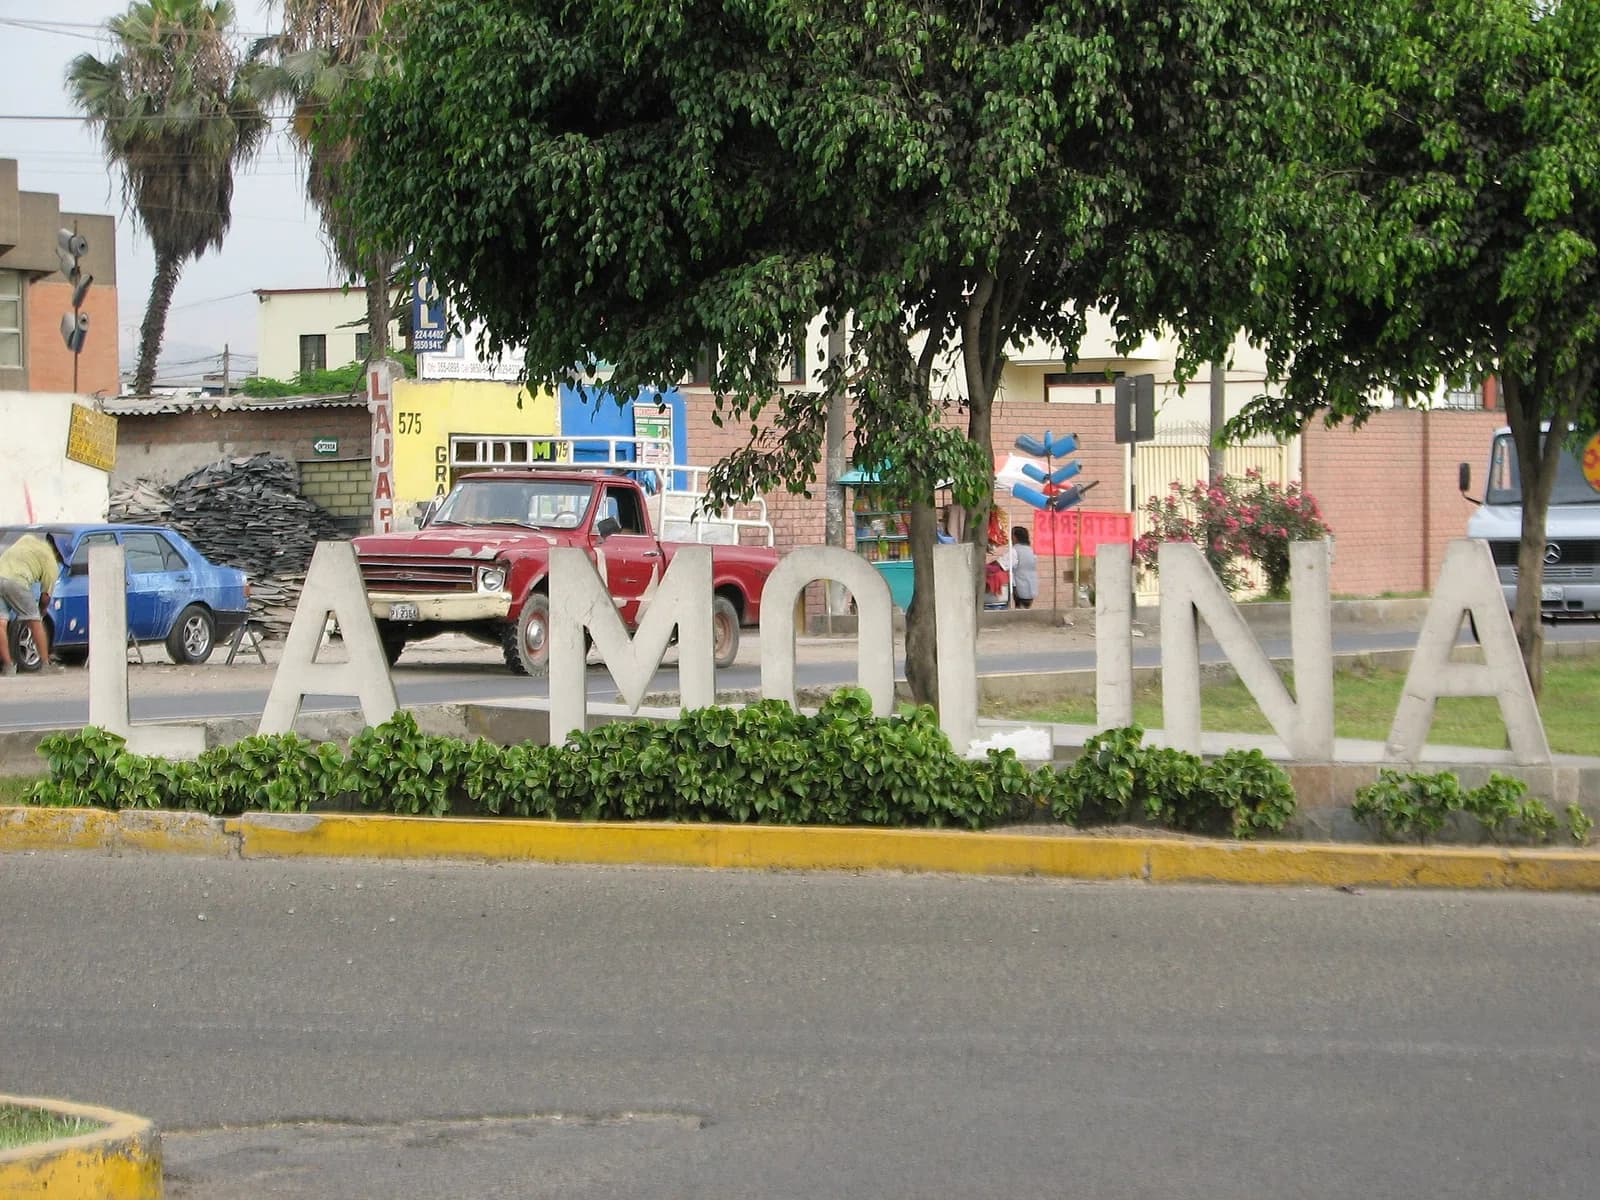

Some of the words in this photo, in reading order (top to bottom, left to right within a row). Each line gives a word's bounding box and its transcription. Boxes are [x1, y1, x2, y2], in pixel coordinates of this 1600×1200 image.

[398, 412, 422, 435] 575
[88, 541, 401, 761] LA
[548, 538, 1552, 766] MOLINA
